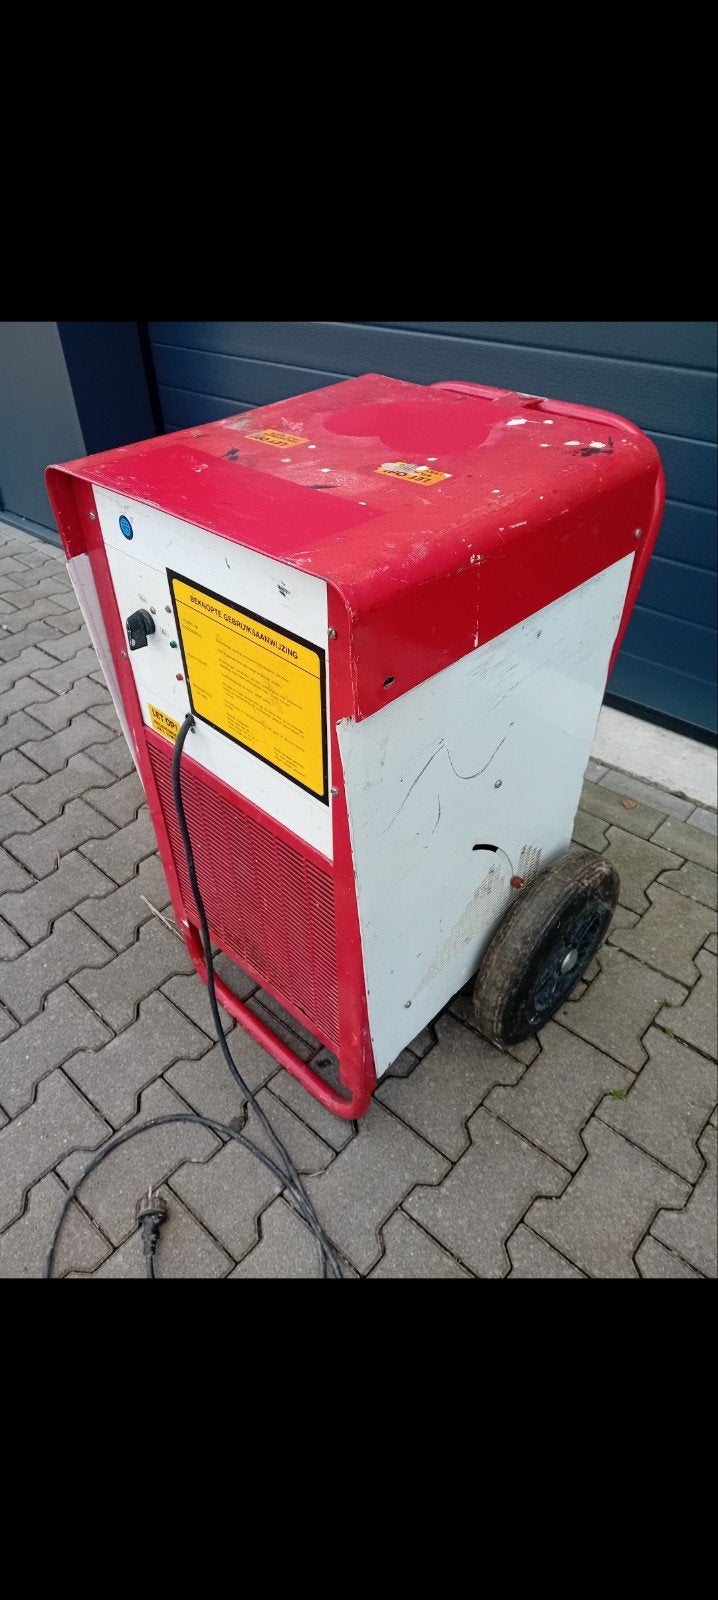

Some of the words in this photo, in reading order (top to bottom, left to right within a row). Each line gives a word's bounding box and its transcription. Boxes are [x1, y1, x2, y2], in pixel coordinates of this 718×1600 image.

[408, 475, 431, 483] LET
[189, 595, 222, 618] BEKNOPTE
[223, 613, 298, 659] GEBRUIKSAANWIJZING
[151, 708, 164, 722] LET
[165, 717, 178, 731] OP!
